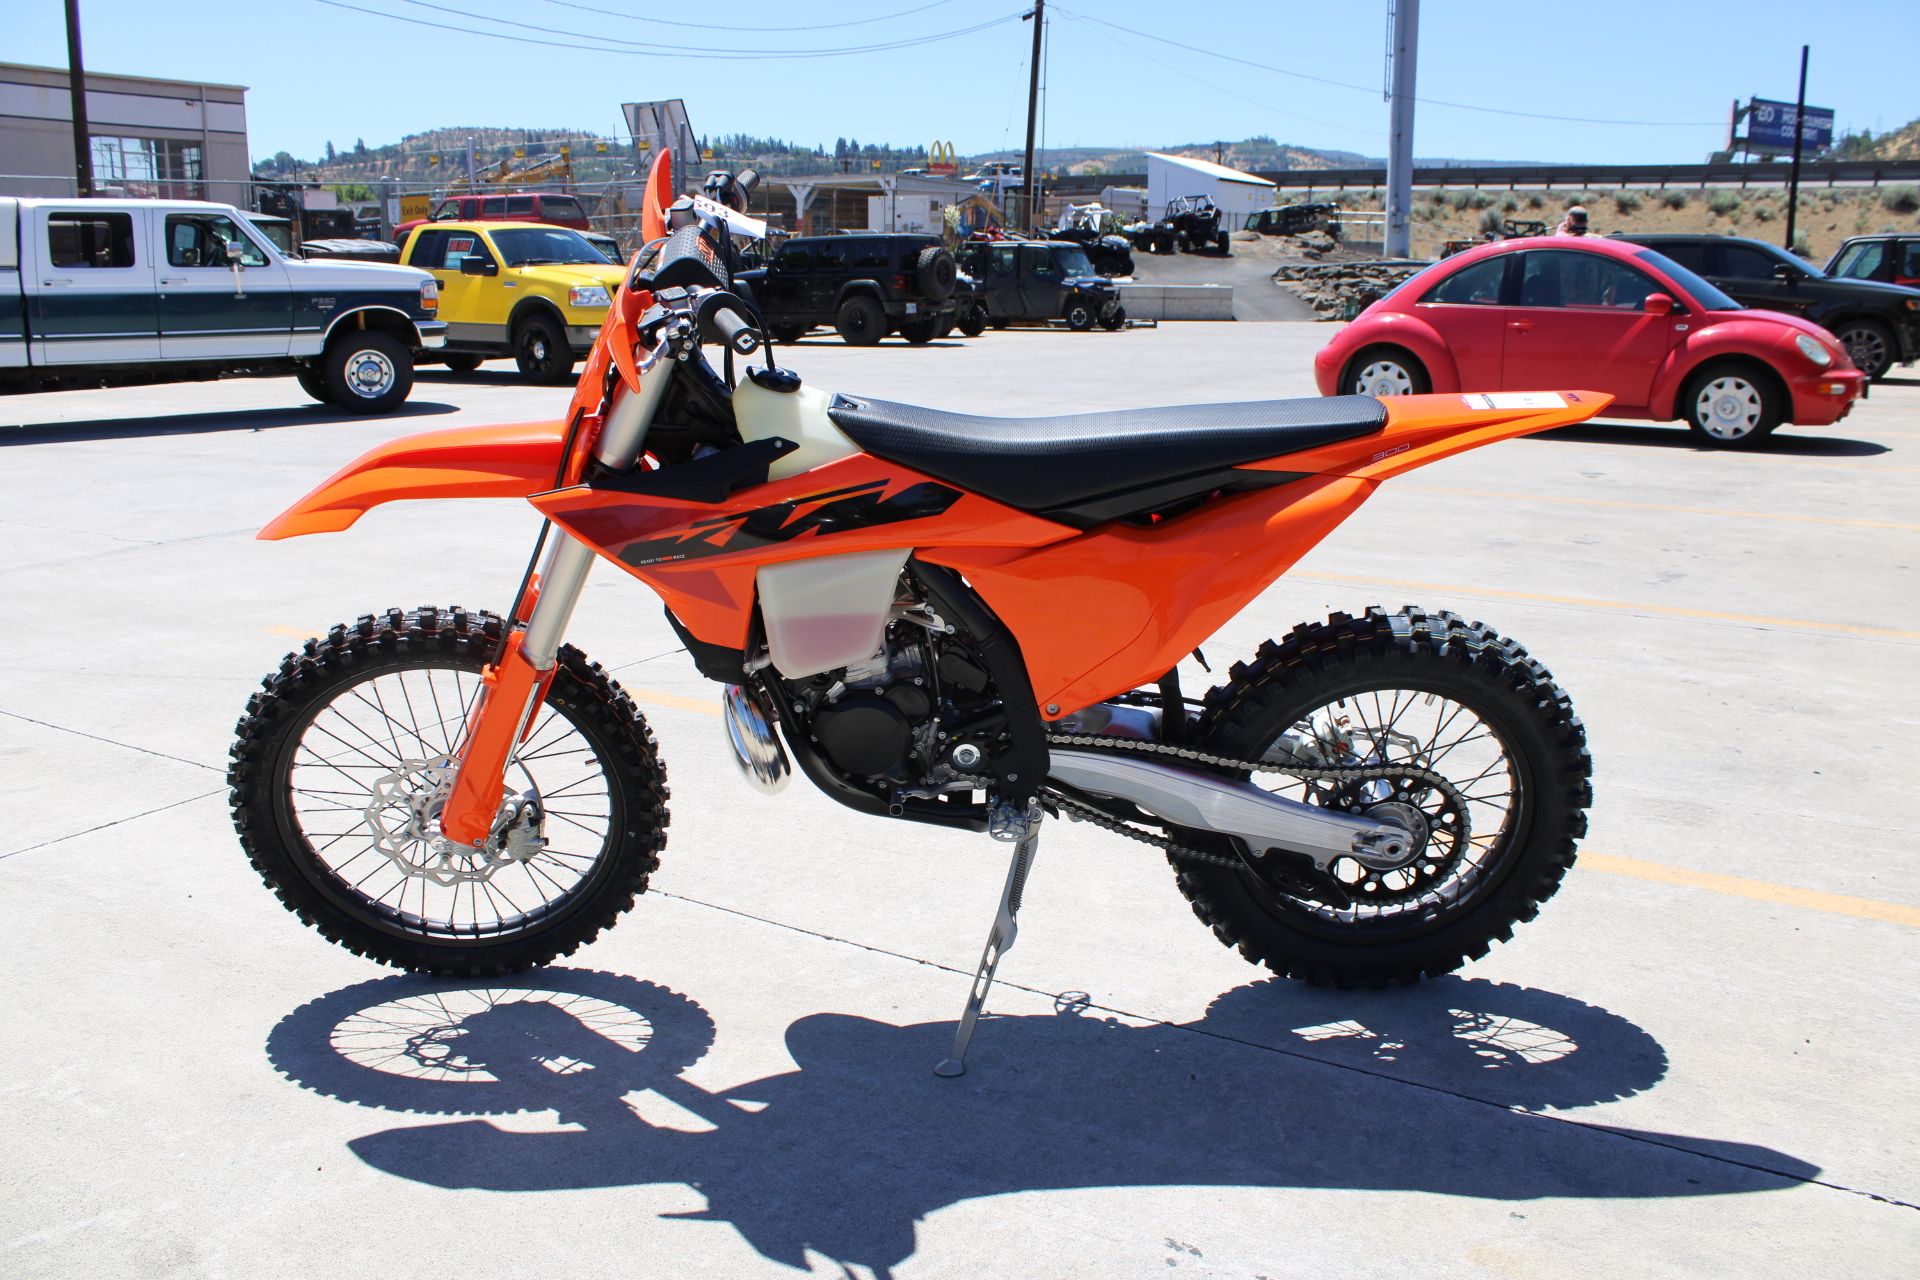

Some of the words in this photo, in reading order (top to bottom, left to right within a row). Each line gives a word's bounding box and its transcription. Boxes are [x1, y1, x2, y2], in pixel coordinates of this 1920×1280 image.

[402, 206, 413, 217] Exit
[414, 205, 428, 217] Only
[1372, 443, 1410, 461] 300
